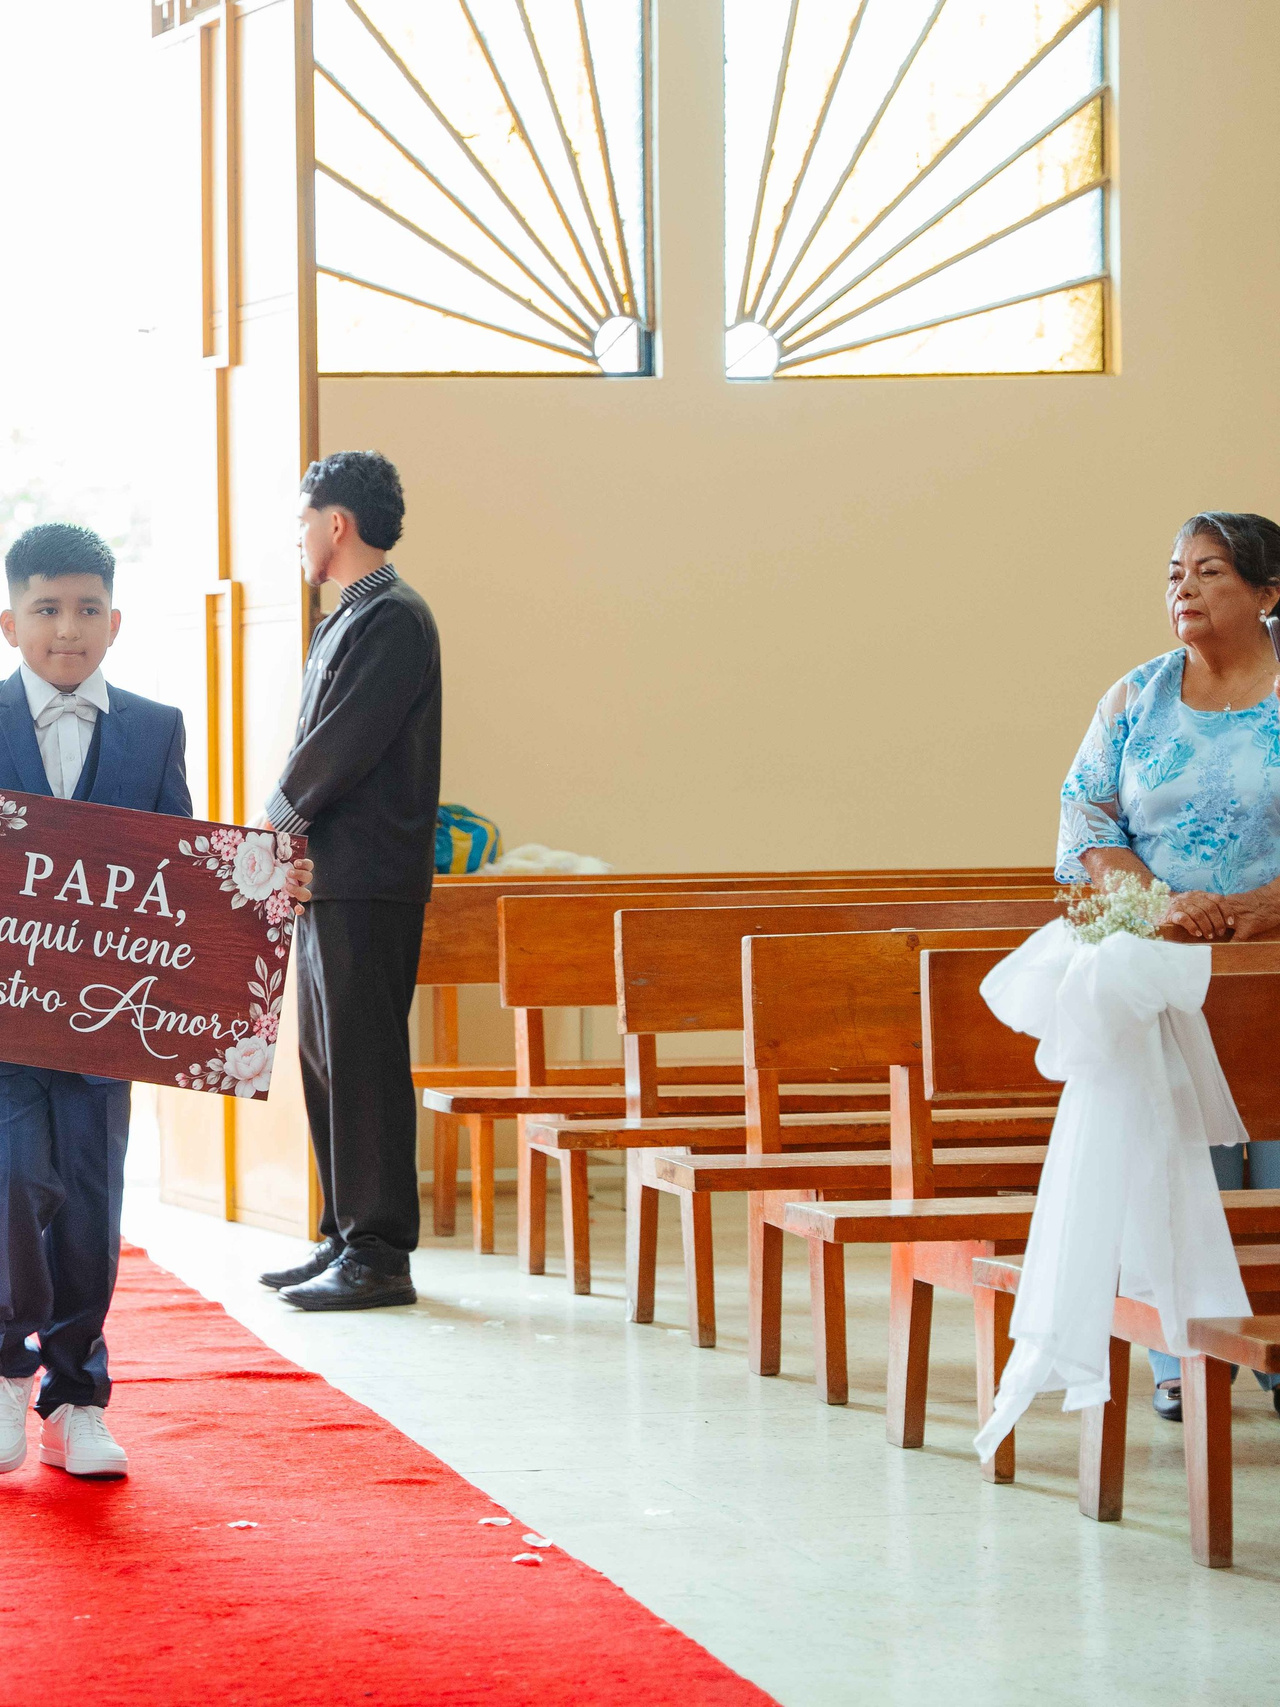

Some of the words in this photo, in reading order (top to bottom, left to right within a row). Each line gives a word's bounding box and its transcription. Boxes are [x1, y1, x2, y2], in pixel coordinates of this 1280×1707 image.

[19, 851, 187, 927] PAPÁ,
[93, 927, 195, 970] viene
[69, 976, 232, 1060] Amor
